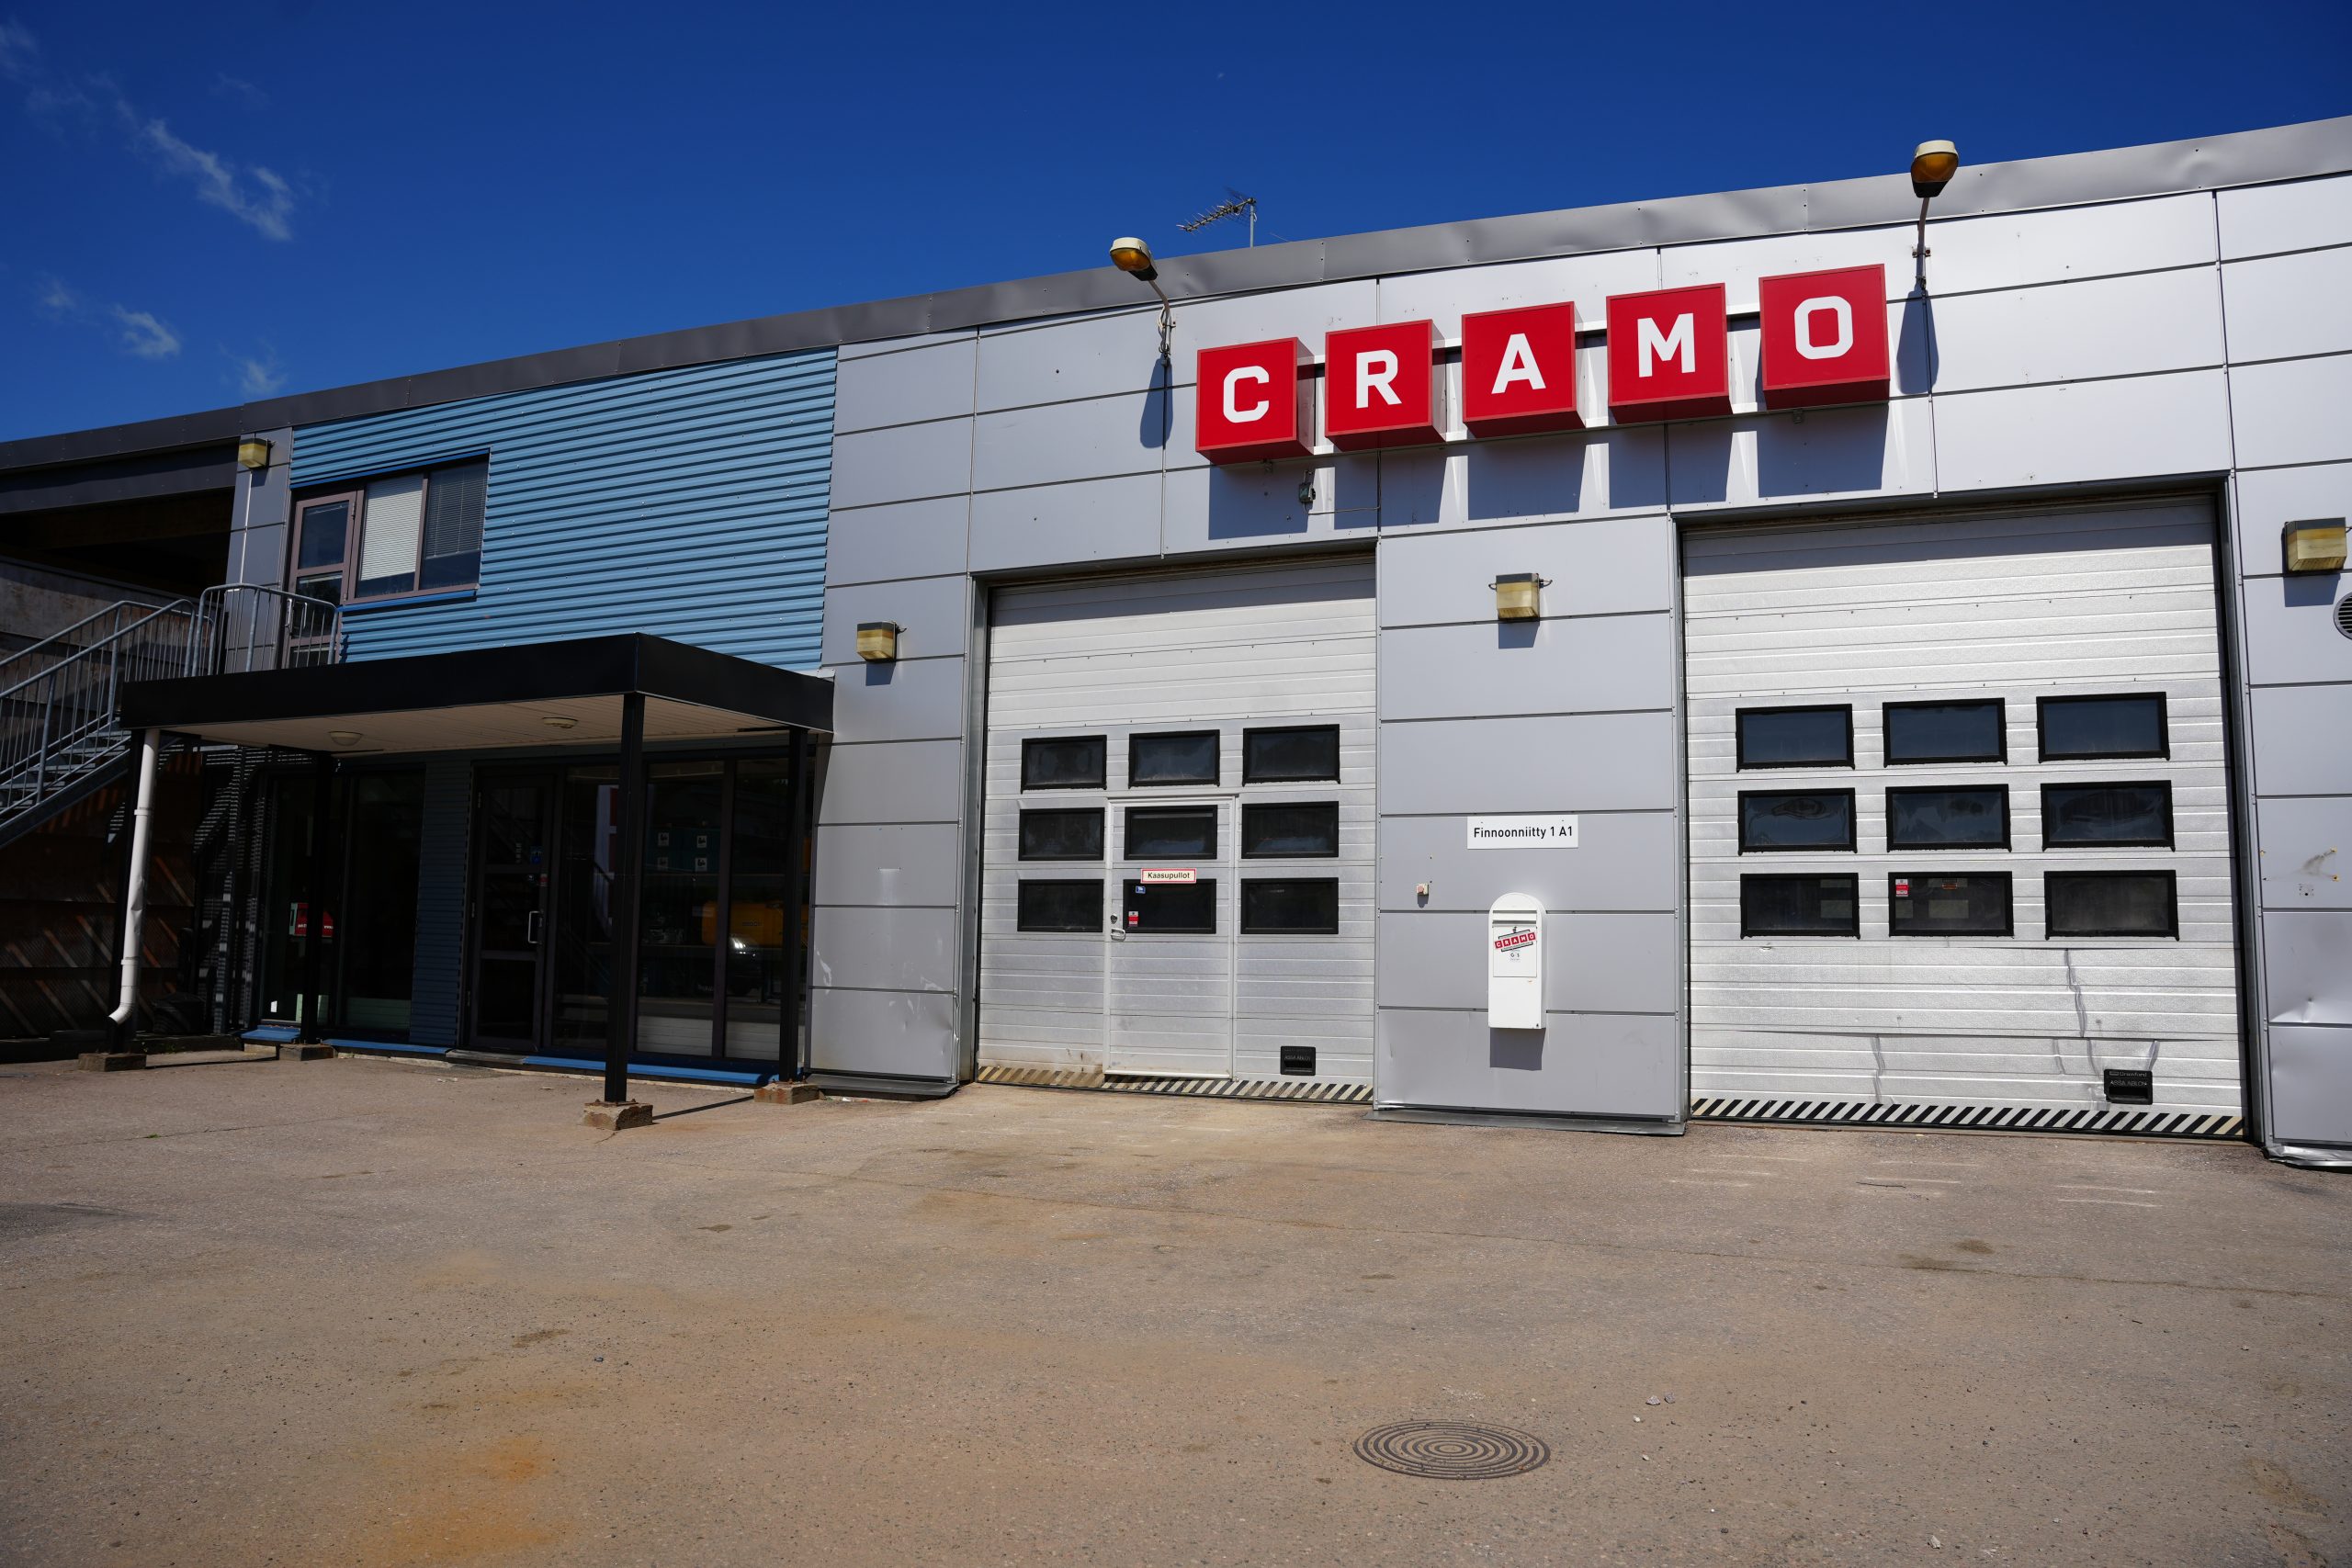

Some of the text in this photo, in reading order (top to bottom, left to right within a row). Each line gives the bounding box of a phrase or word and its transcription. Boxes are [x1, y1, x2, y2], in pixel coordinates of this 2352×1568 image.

[1223, 295, 1854, 423] CRAMO
[1474, 826, 1572, 840] Finnoonniitty 1 A1
[1148, 872, 1190, 880] Kaasupullot
[1496, 933, 1535, 948] CRAMO
